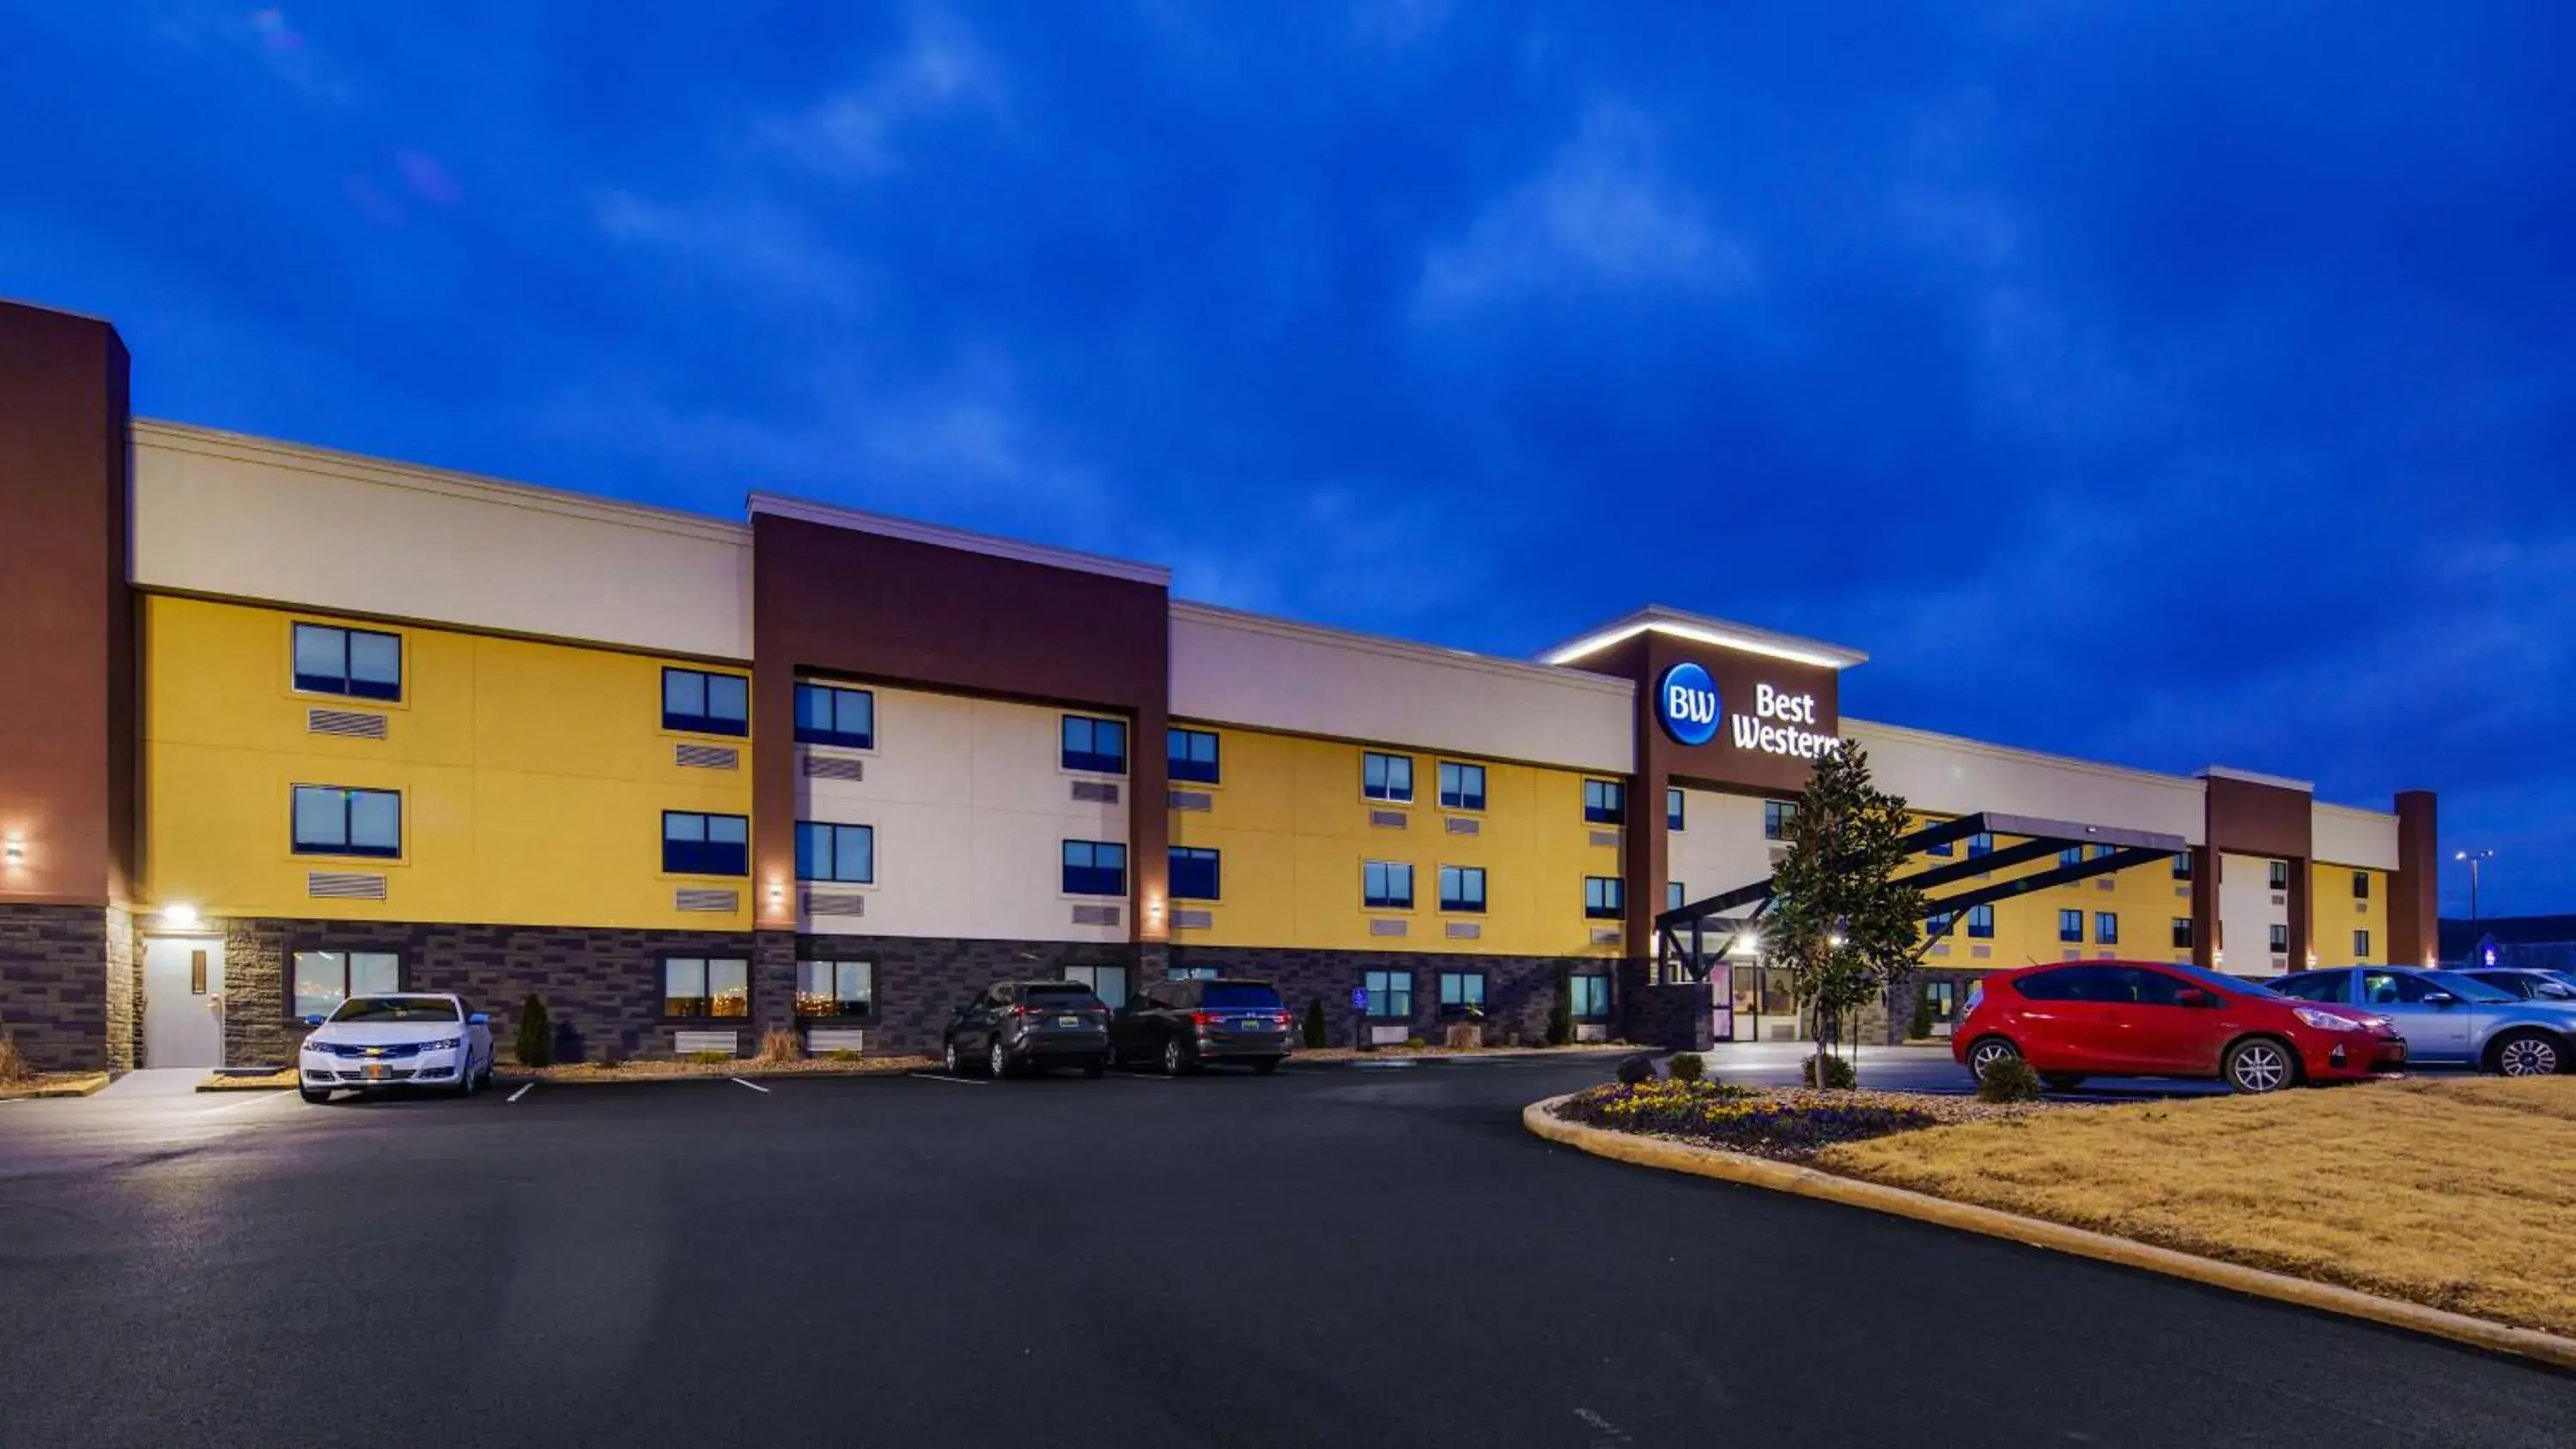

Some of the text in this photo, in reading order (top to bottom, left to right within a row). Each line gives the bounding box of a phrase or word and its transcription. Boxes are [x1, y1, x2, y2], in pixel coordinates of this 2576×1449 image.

[1669, 685, 1716, 724] BW
[1756, 683, 1815, 724] Best
[1731, 713, 1843, 761] Western
